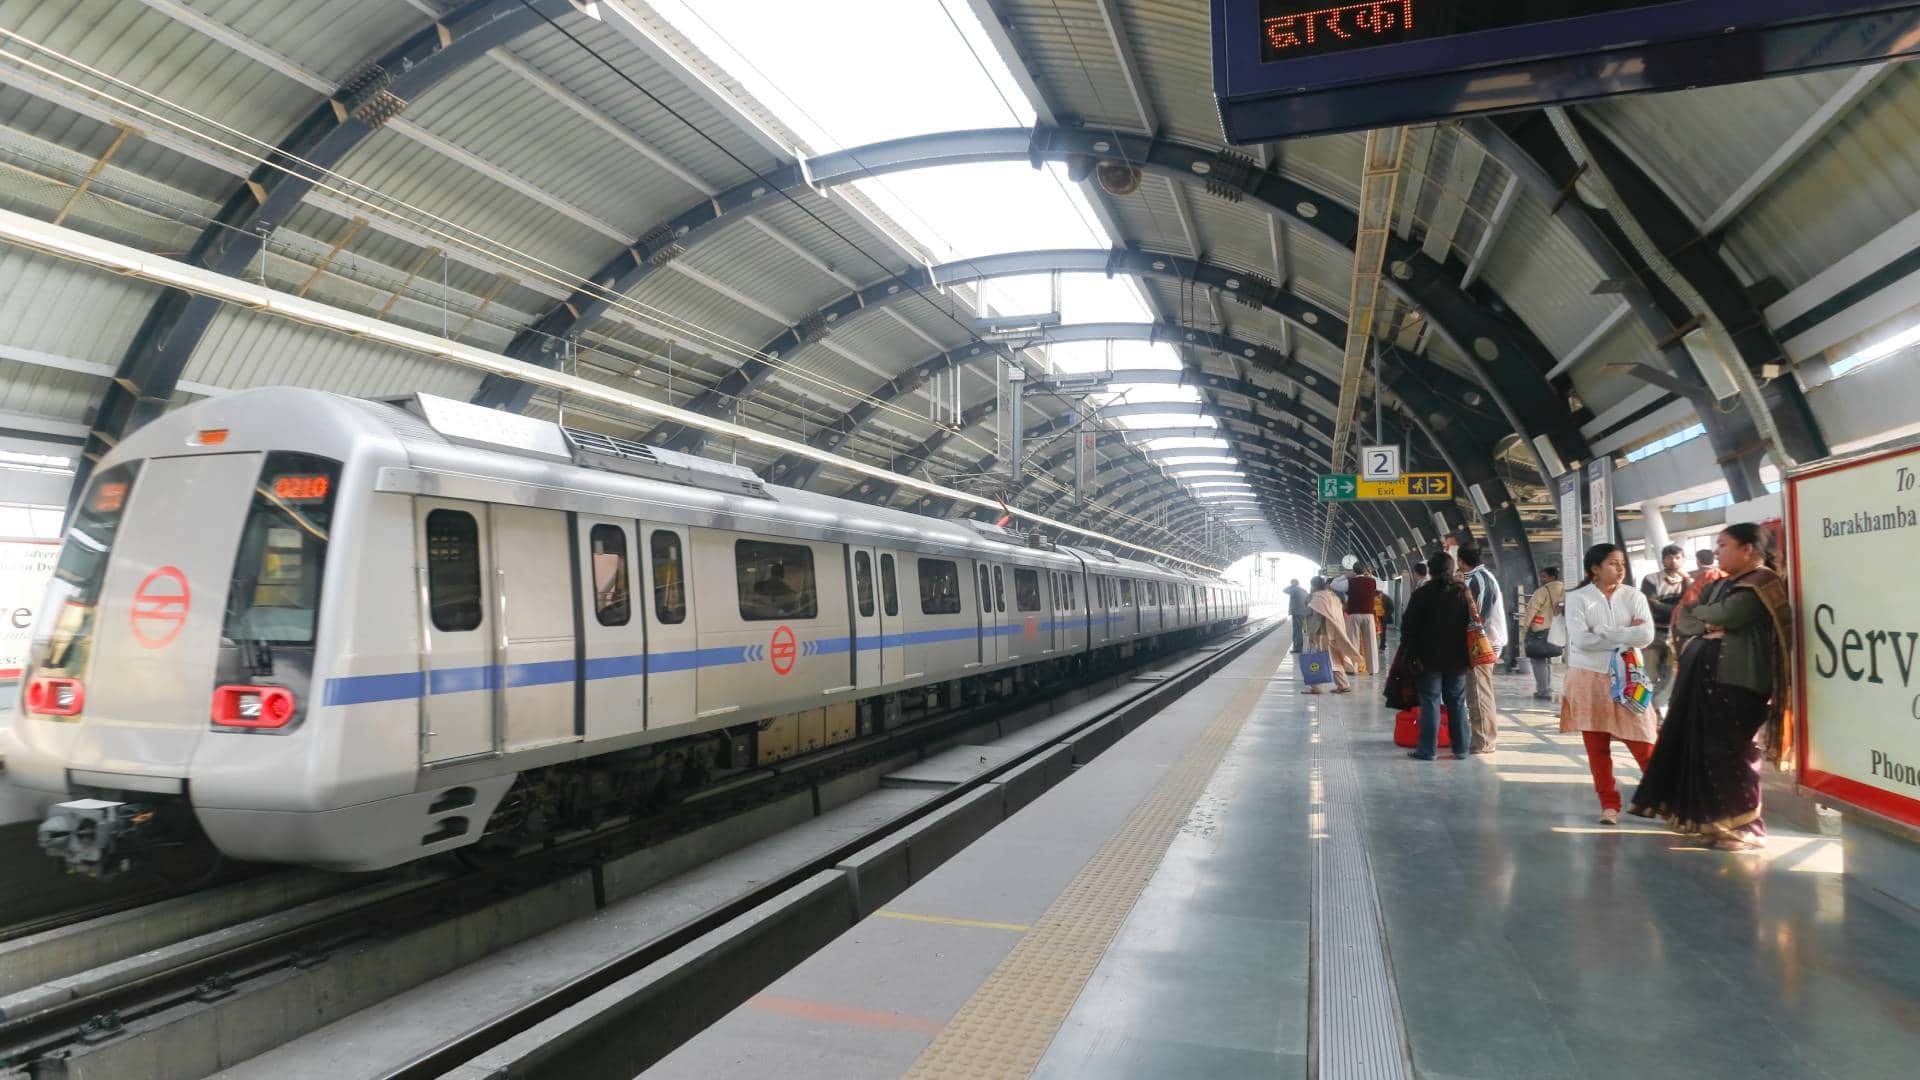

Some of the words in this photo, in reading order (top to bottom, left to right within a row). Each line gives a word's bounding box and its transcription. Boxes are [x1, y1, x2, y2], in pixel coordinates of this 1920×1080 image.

[1373, 453, 1389, 473] 2
[1377, 487, 1394, 496] Exit
[1896, 467, 1915, 492] To
[1823, 505, 1917, 538] Barakhamba
[1814, 602, 1919, 687] Serv
